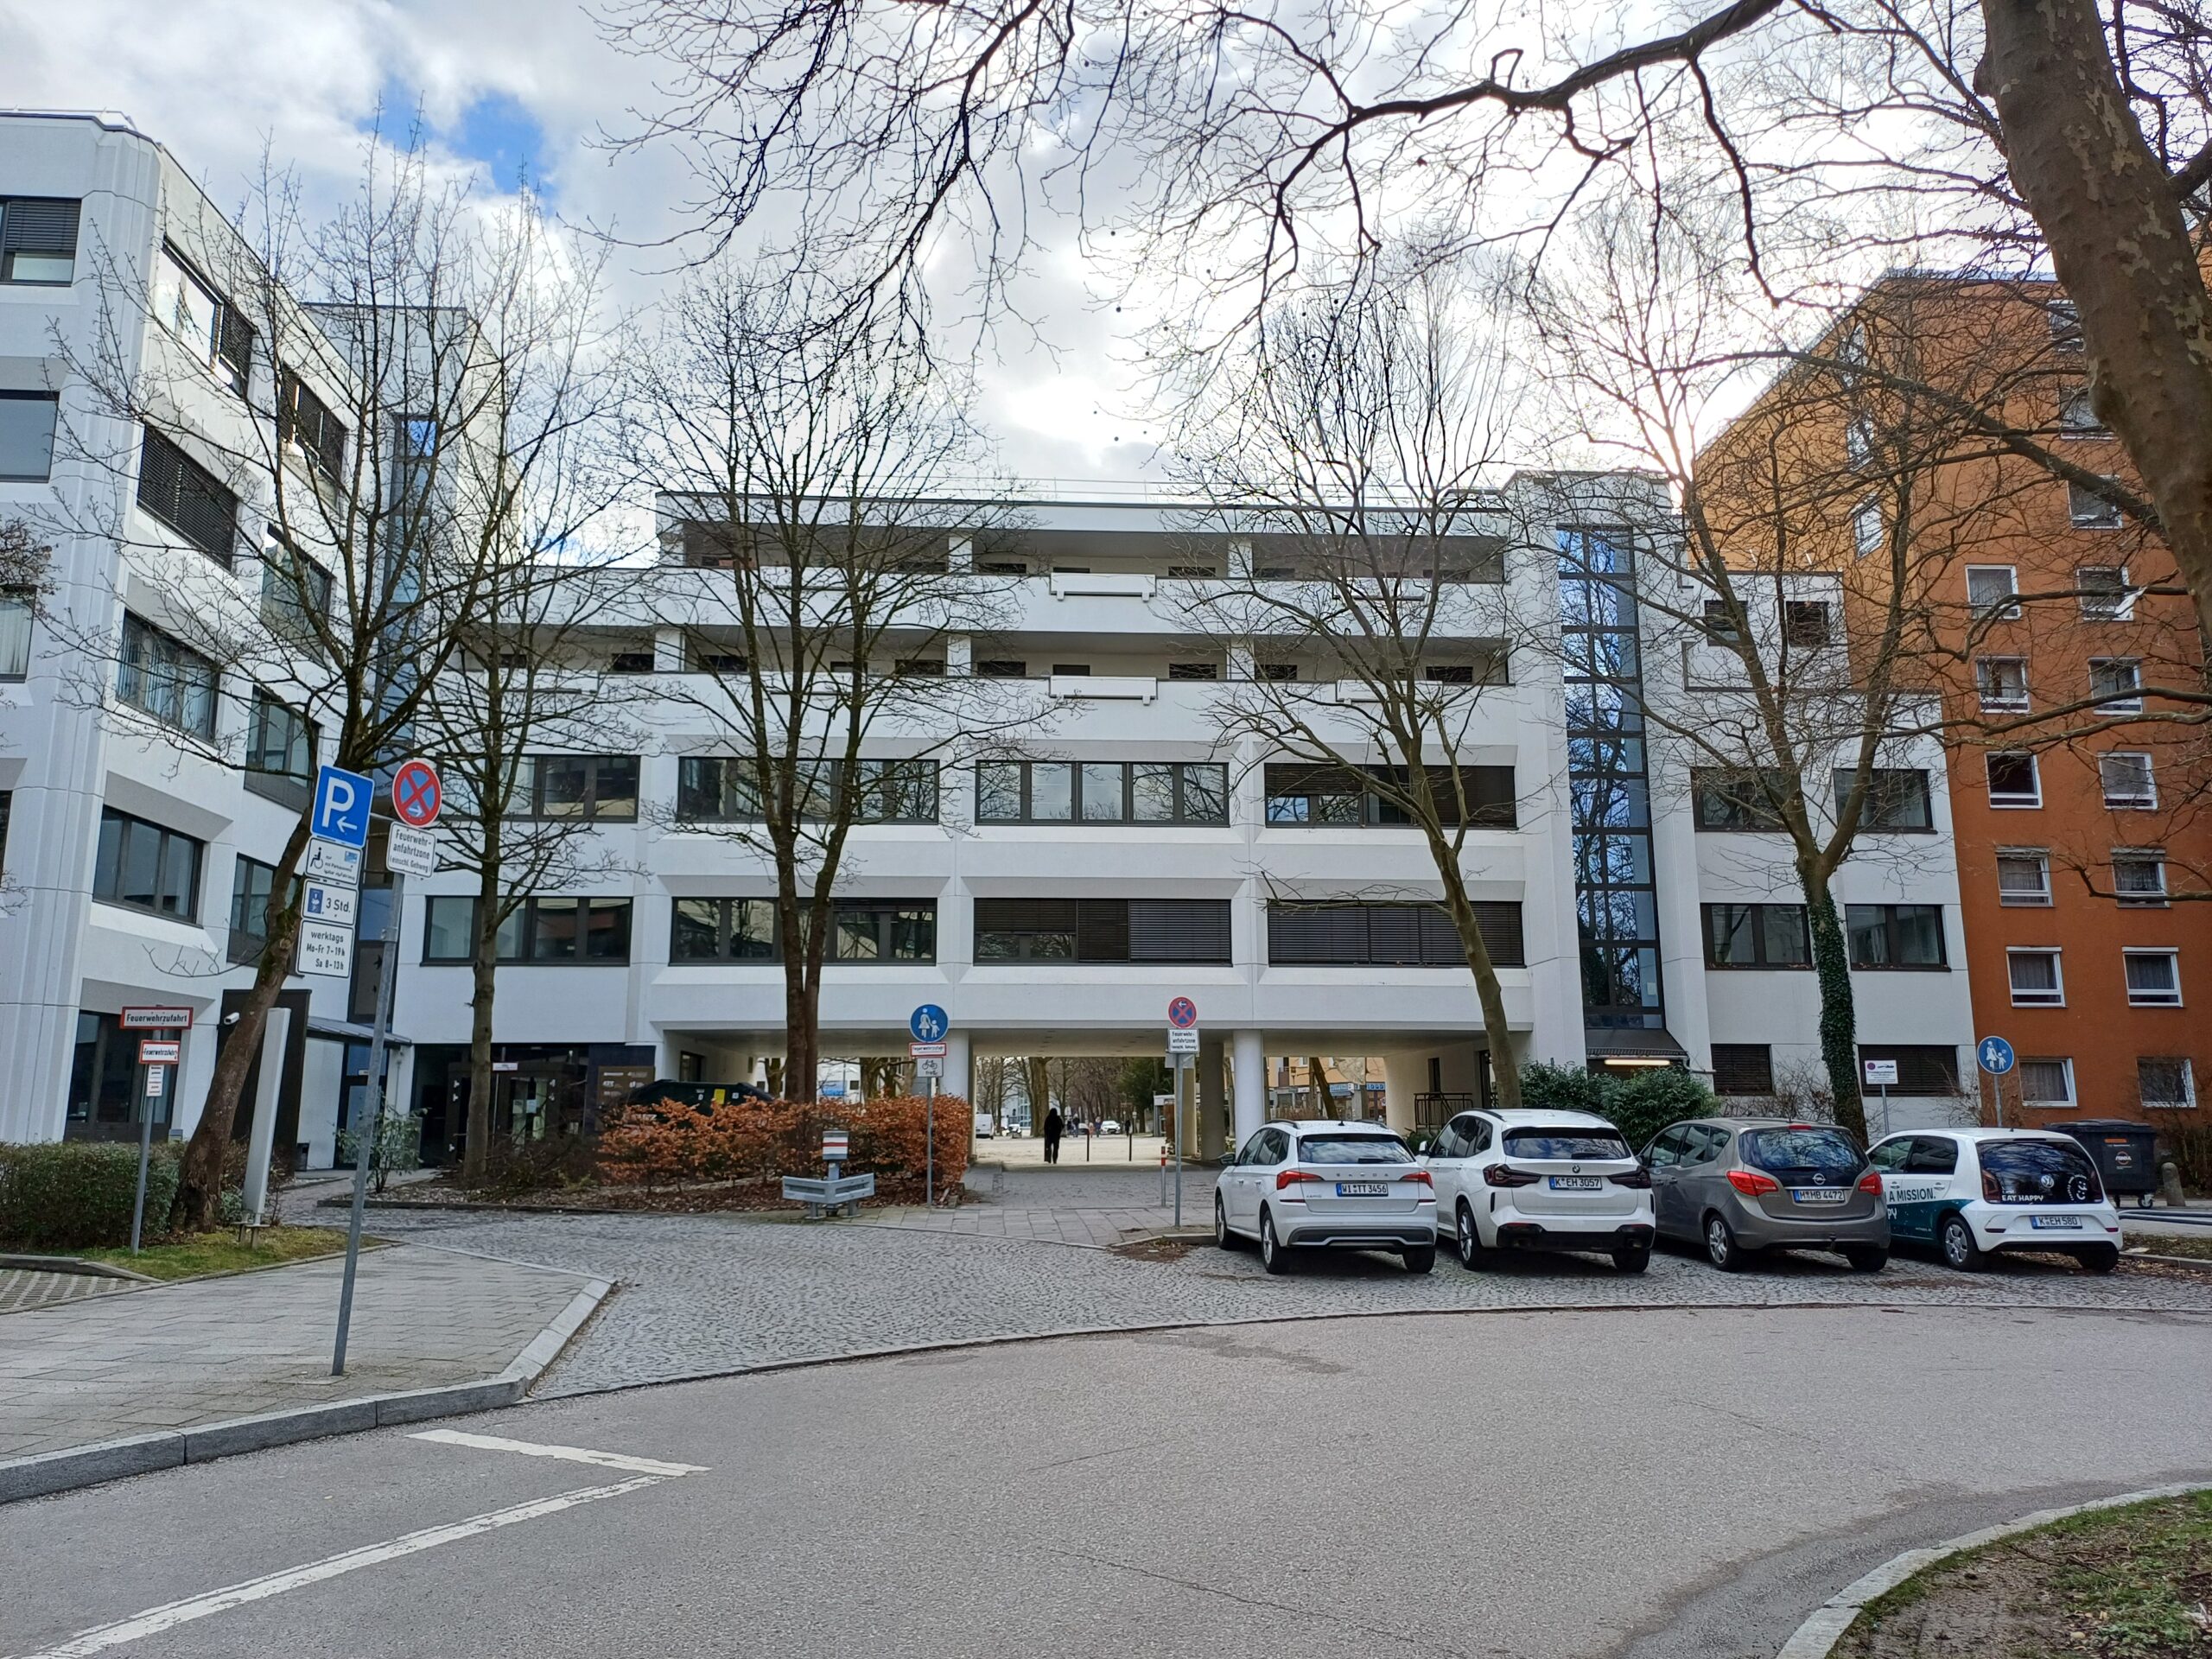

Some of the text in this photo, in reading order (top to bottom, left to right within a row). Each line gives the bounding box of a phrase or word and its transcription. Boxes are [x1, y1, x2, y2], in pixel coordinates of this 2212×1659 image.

[321, 776, 354, 828] P
[396, 830, 431, 847] Feuerwehr-
[393, 843, 430, 860] anfahrtzone
[326, 898, 351, 913] 3 Std.
[311, 931, 344, 944] werktags
[306, 943, 324, 954] Mo-Fr
[315, 958, 323, 968] Sa
[126, 1014, 188, 1023] Feuerwehrzufahrt
[1357, 1184, 1366, 1193] TT
[1368, 1184, 1387, 1193] 3456
[1555, 1178, 1599, 1187] K EH 3057
[1889, 1191, 1895, 1202] A
[1897, 1187, 1936, 1202] MISSION.
